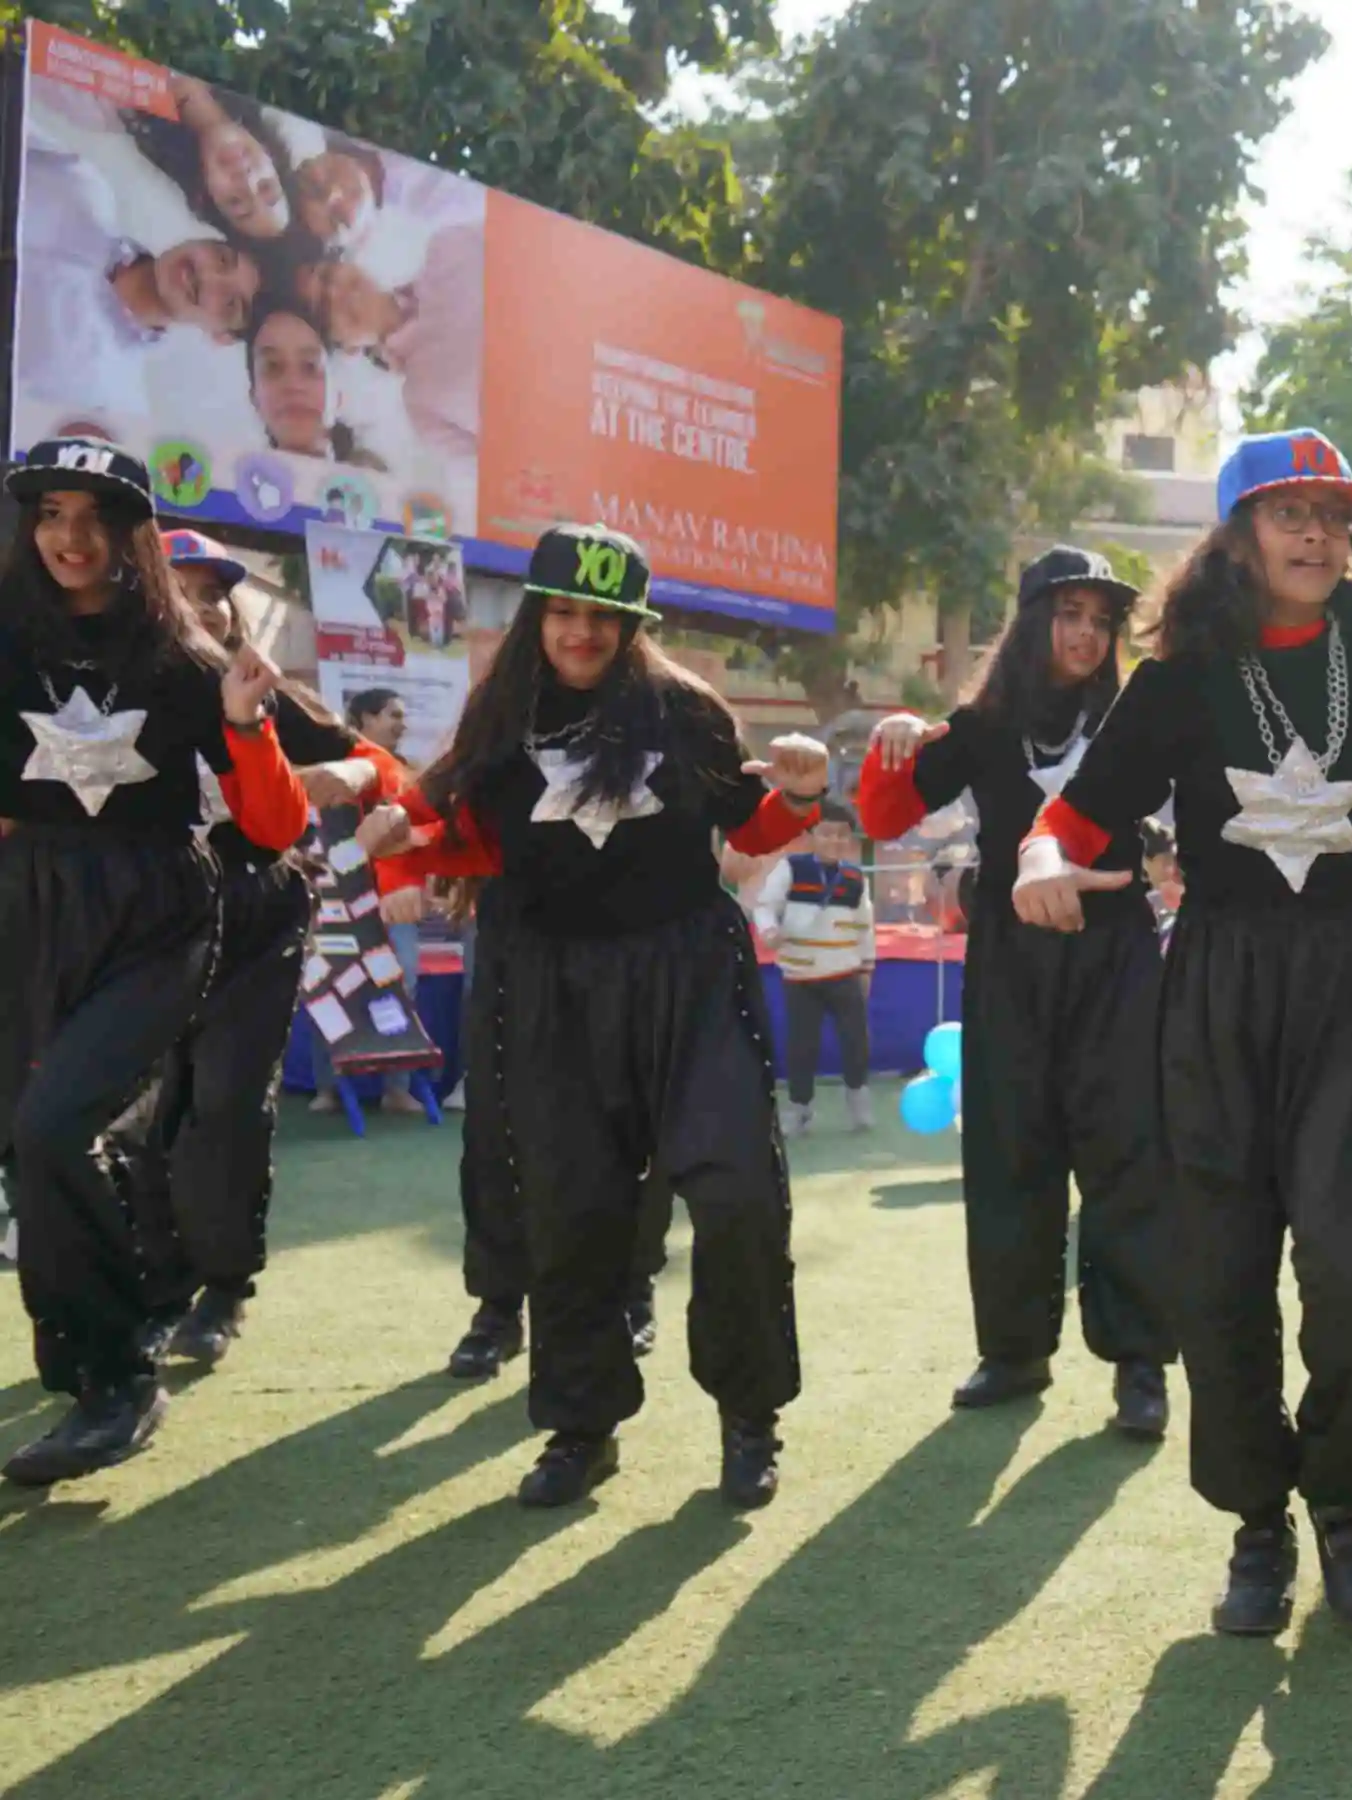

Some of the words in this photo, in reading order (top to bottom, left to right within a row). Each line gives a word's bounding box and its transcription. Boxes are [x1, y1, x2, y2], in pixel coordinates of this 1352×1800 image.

[591, 396, 621, 438] AT
[627, 409, 666, 452] THE
[57, 443, 114, 475] YO!
[592, 490, 706, 542] MANAV
[574, 540, 628, 597] YO!
